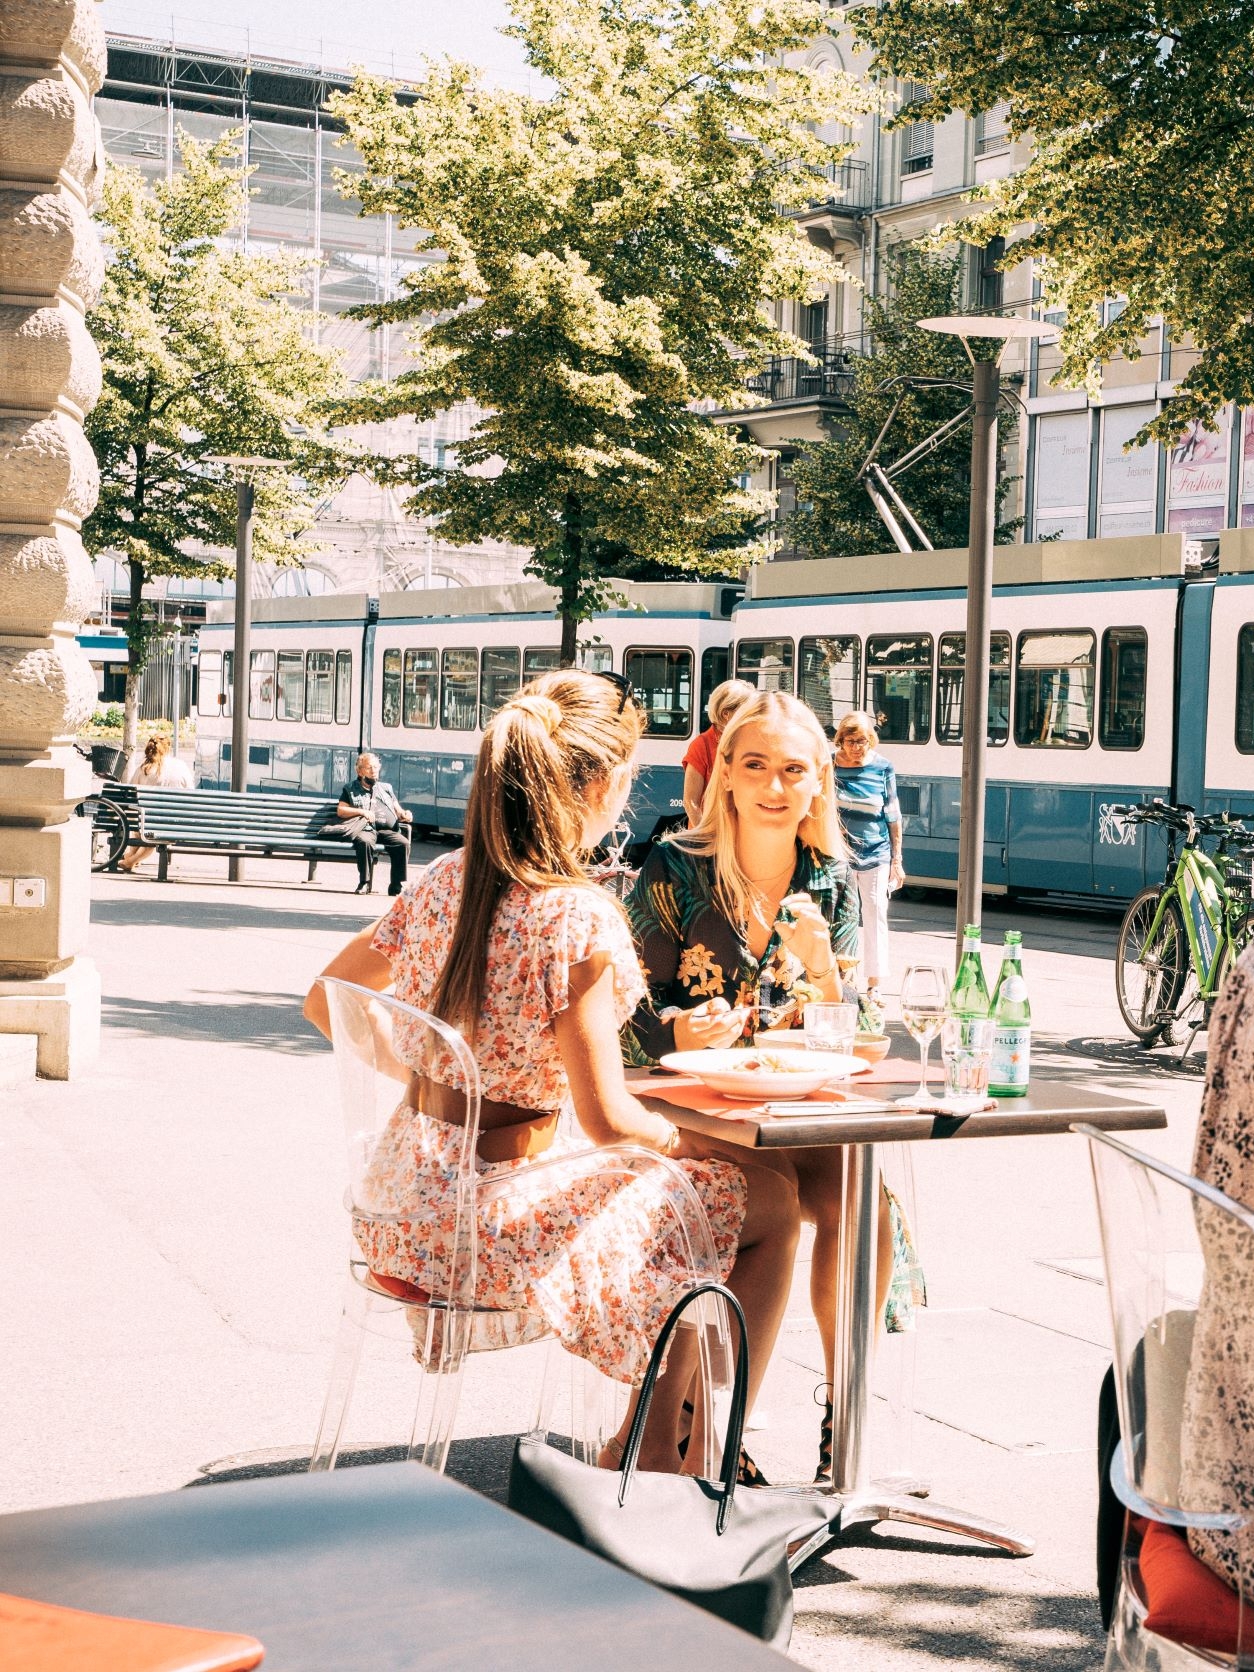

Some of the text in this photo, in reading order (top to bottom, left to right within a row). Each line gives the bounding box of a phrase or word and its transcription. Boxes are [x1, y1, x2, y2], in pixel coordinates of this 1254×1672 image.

[1172, 466, 1223, 493] Fashion
[1181, 515, 1213, 528] pedicure
[669, 798, 684, 808] 209
